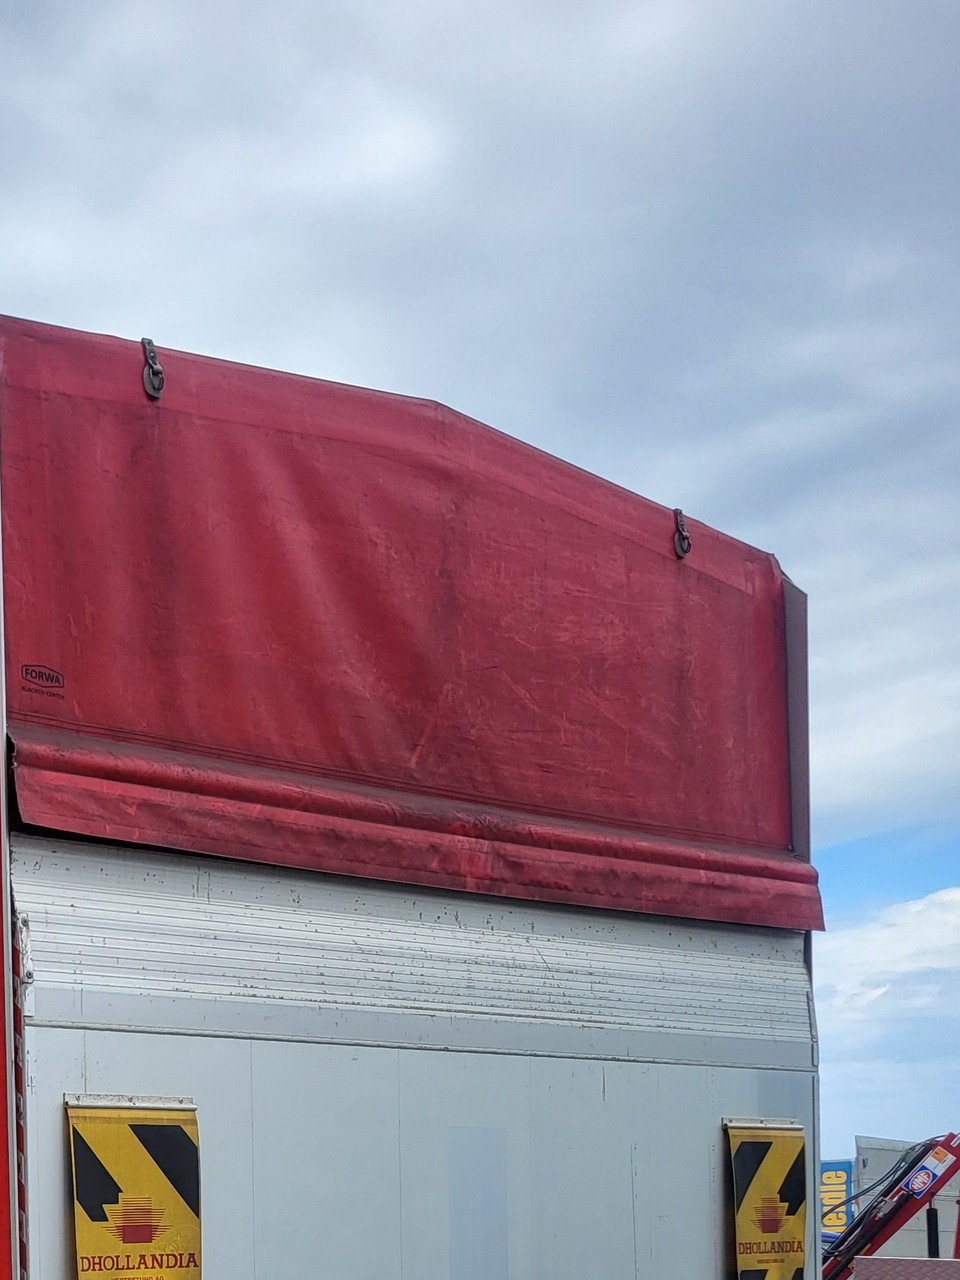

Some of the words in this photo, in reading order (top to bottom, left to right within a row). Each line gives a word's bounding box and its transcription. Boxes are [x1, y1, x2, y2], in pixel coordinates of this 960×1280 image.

[24, 668, 62, 685] FORWA
[738, 1241, 804, 1255] DHOLLANDIA
[80, 1252, 200, 1272] DHOLLANDIA
